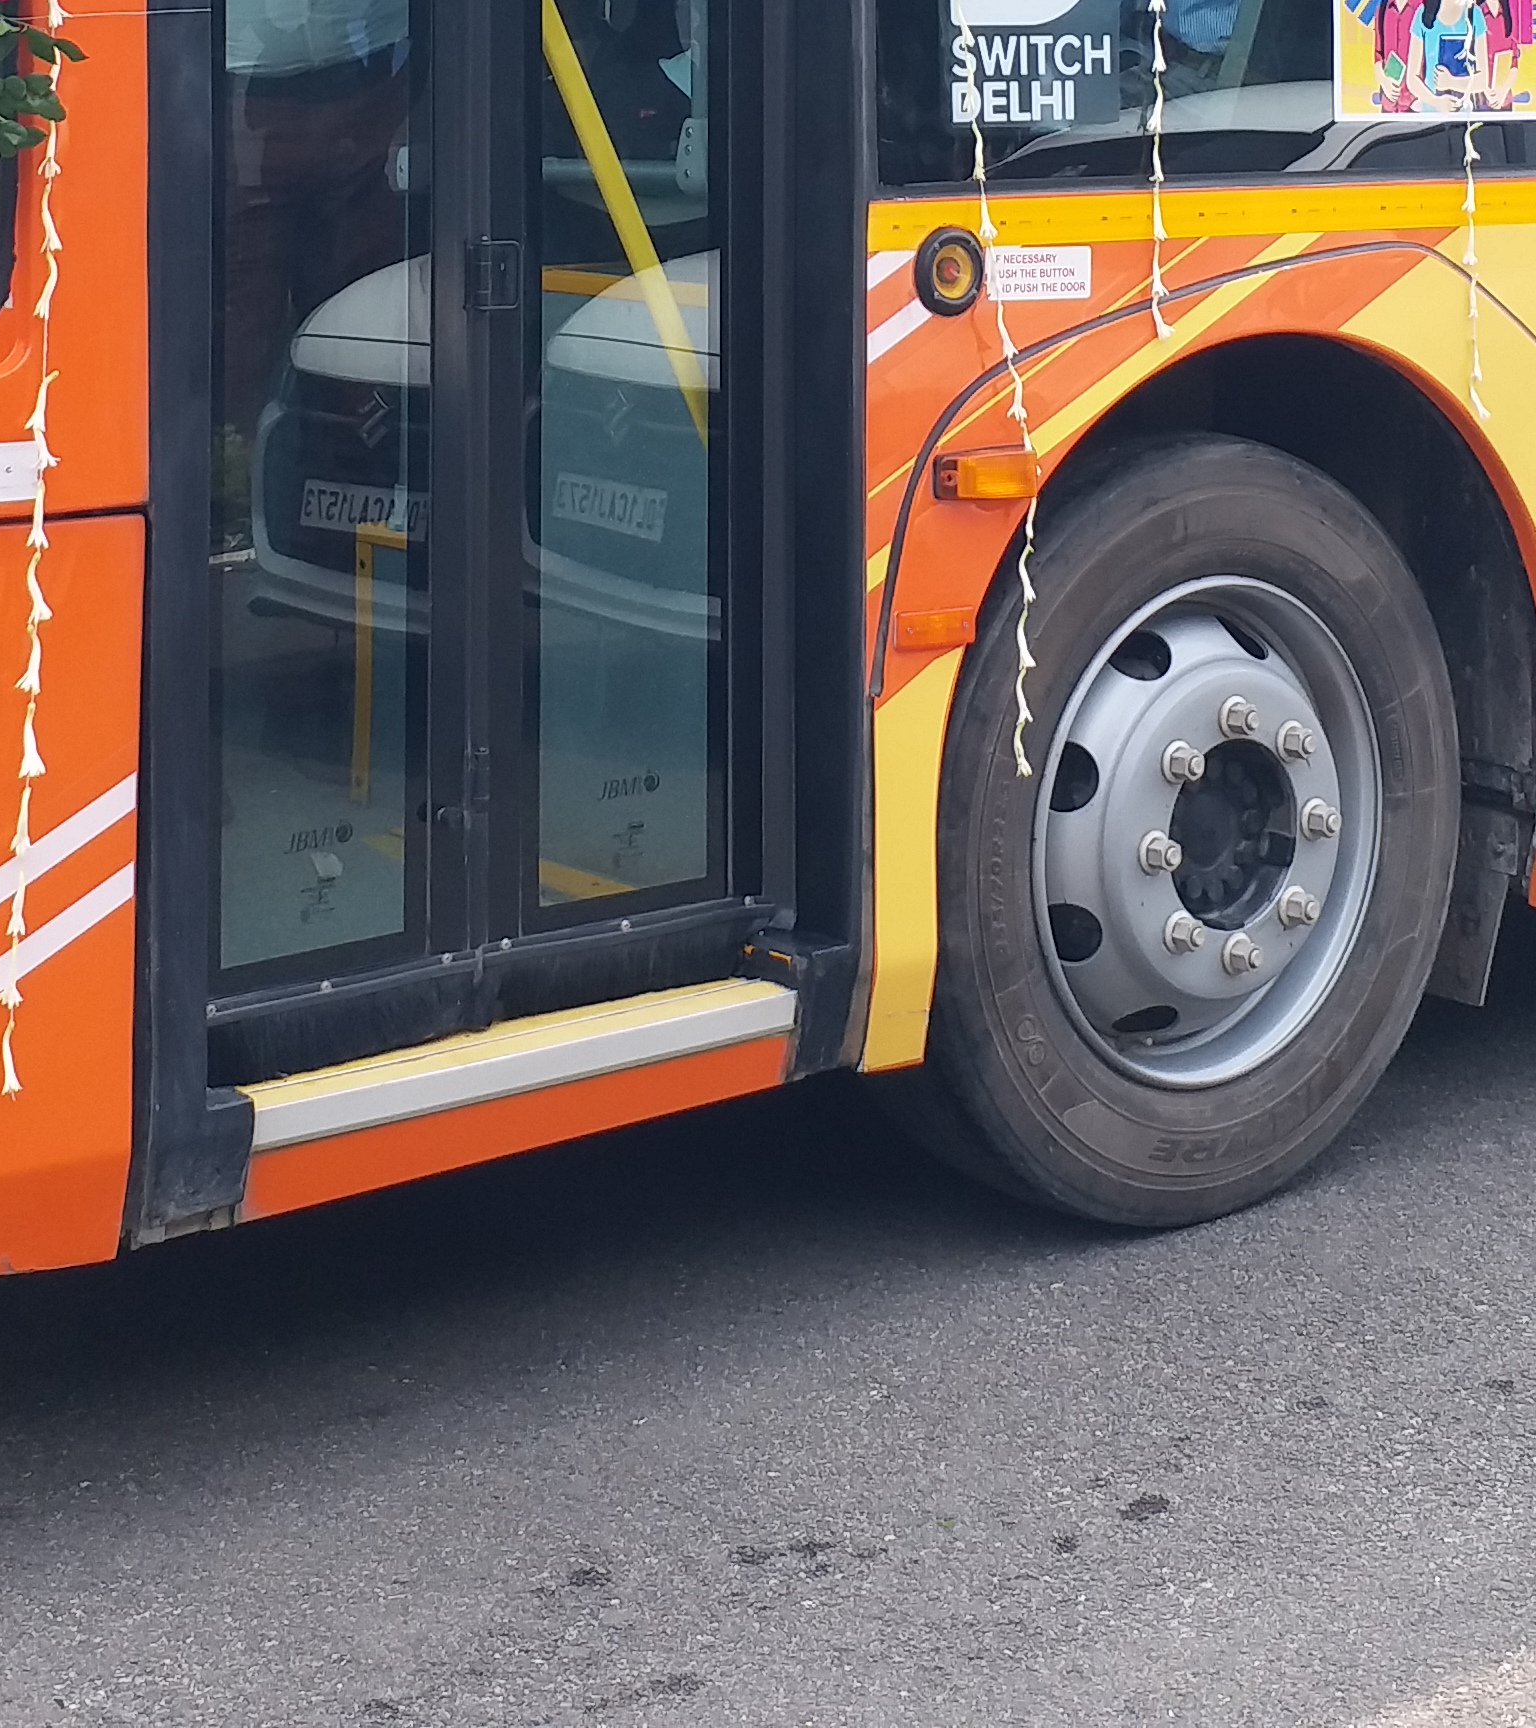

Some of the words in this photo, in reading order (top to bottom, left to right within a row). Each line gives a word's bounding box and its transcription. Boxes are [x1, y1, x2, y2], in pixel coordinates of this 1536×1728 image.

[951, 34, 1112, 77] SWITCH
[951, 80, 1075, 123] DELHI
[1003, 254, 1057, 264] NECESSARY
[997, 268, 1017, 279] USH
[1020, 268, 1037, 278] THE
[1039, 267, 1075, 278] BUTTON
[1014, 283, 1038, 293] PUSH
[1041, 282, 1058, 292] THE
[1060, 282, 1086, 292] DOOR
[284, 827, 334, 855] JBM
